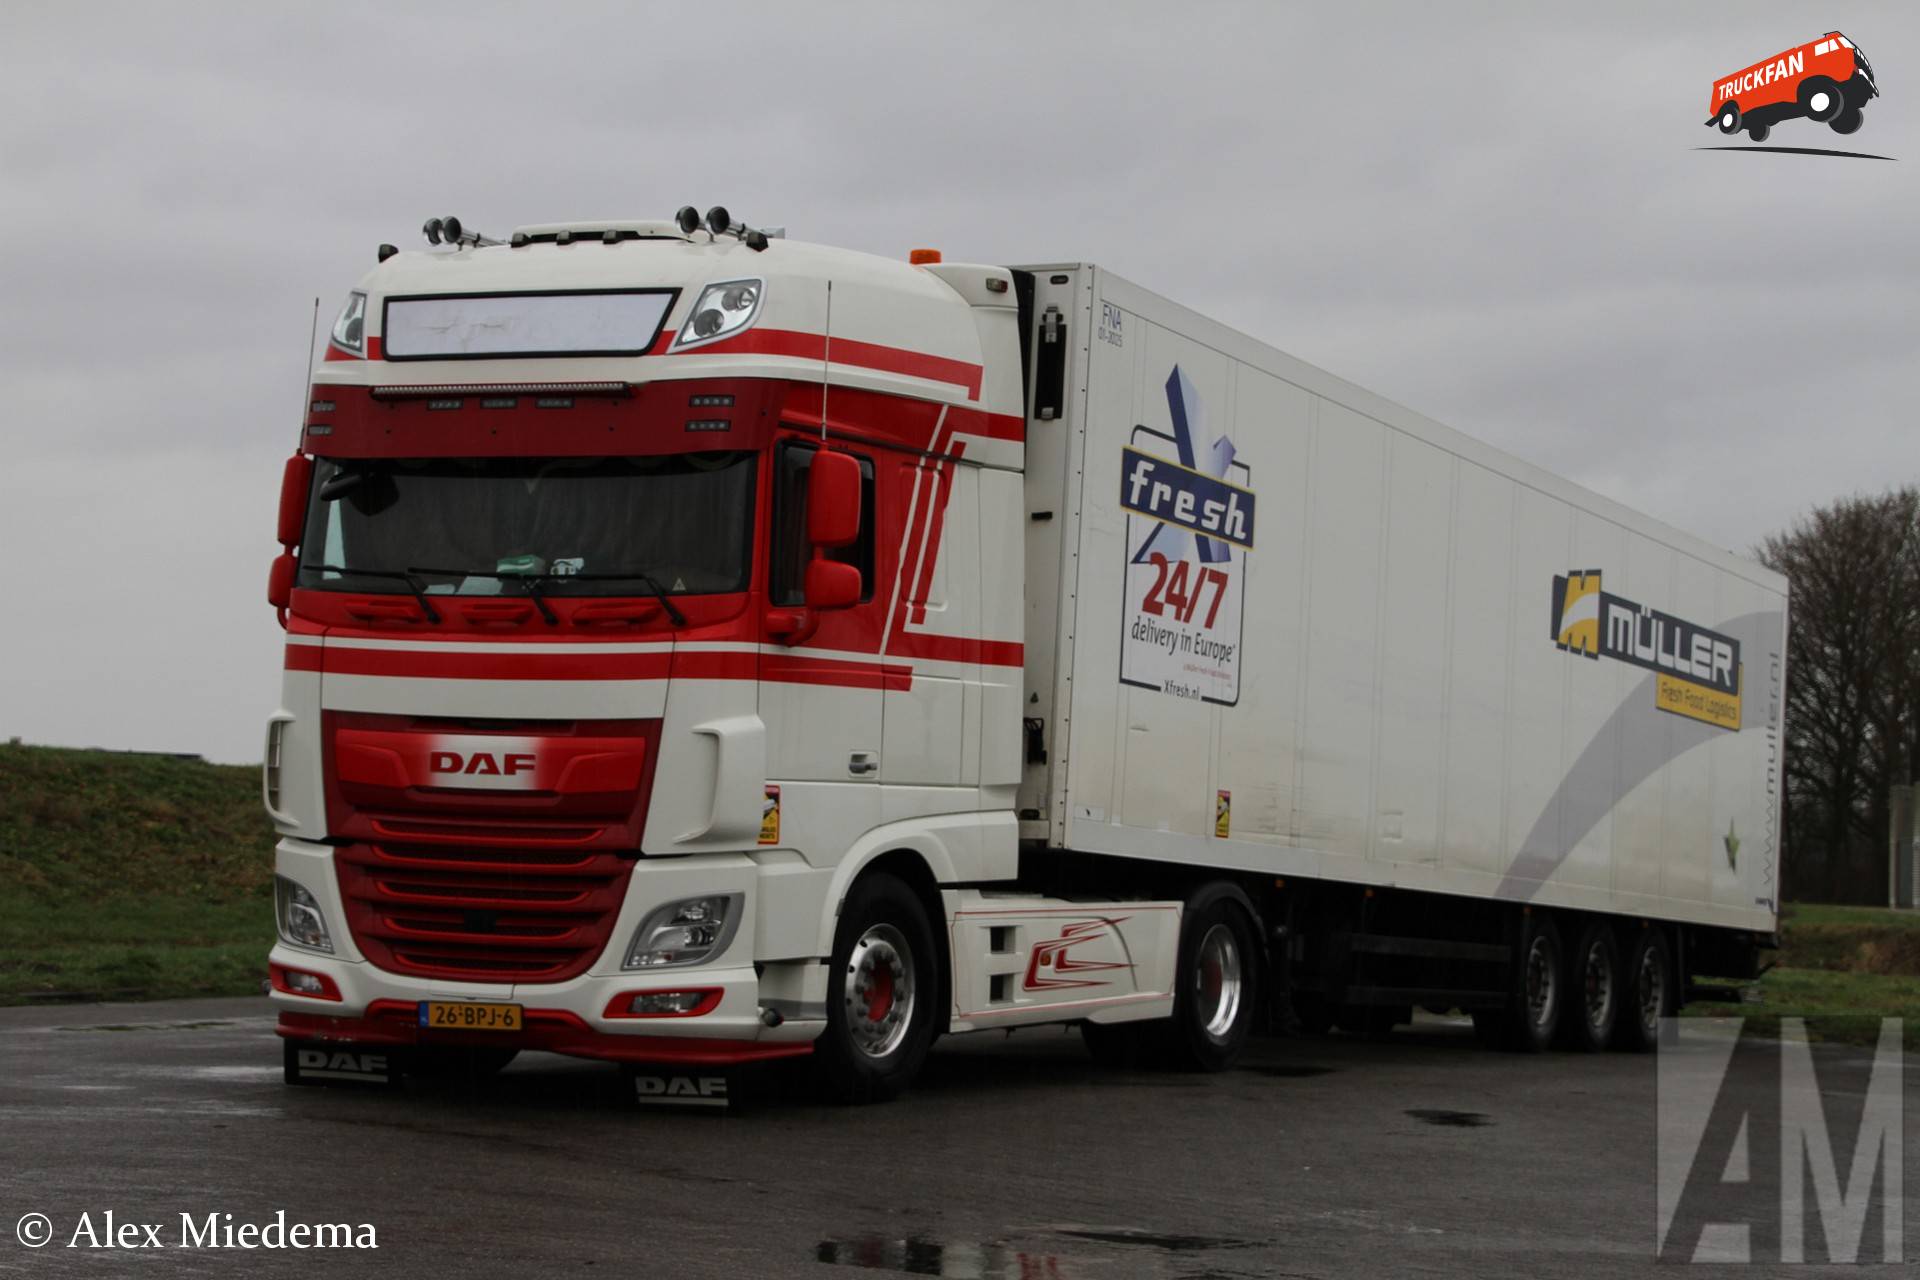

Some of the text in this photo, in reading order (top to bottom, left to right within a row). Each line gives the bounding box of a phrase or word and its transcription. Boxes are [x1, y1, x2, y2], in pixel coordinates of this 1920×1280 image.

[1102, 304, 1122, 332] FNA
[1129, 459, 1247, 540] fresh
[1142, 551, 1229, 630] 24/7
[1131, 615, 1179, 656] delivery
[1180, 628, 1192, 653] in
[1607, 602, 1733, 688] MÜLLER
[1163, 679, 1200, 701] Xfresh.nl
[430, 751, 537, 776] DAF
[298, 1049, 388, 1071] DAF
[635, 1076, 728, 1095] DAF
